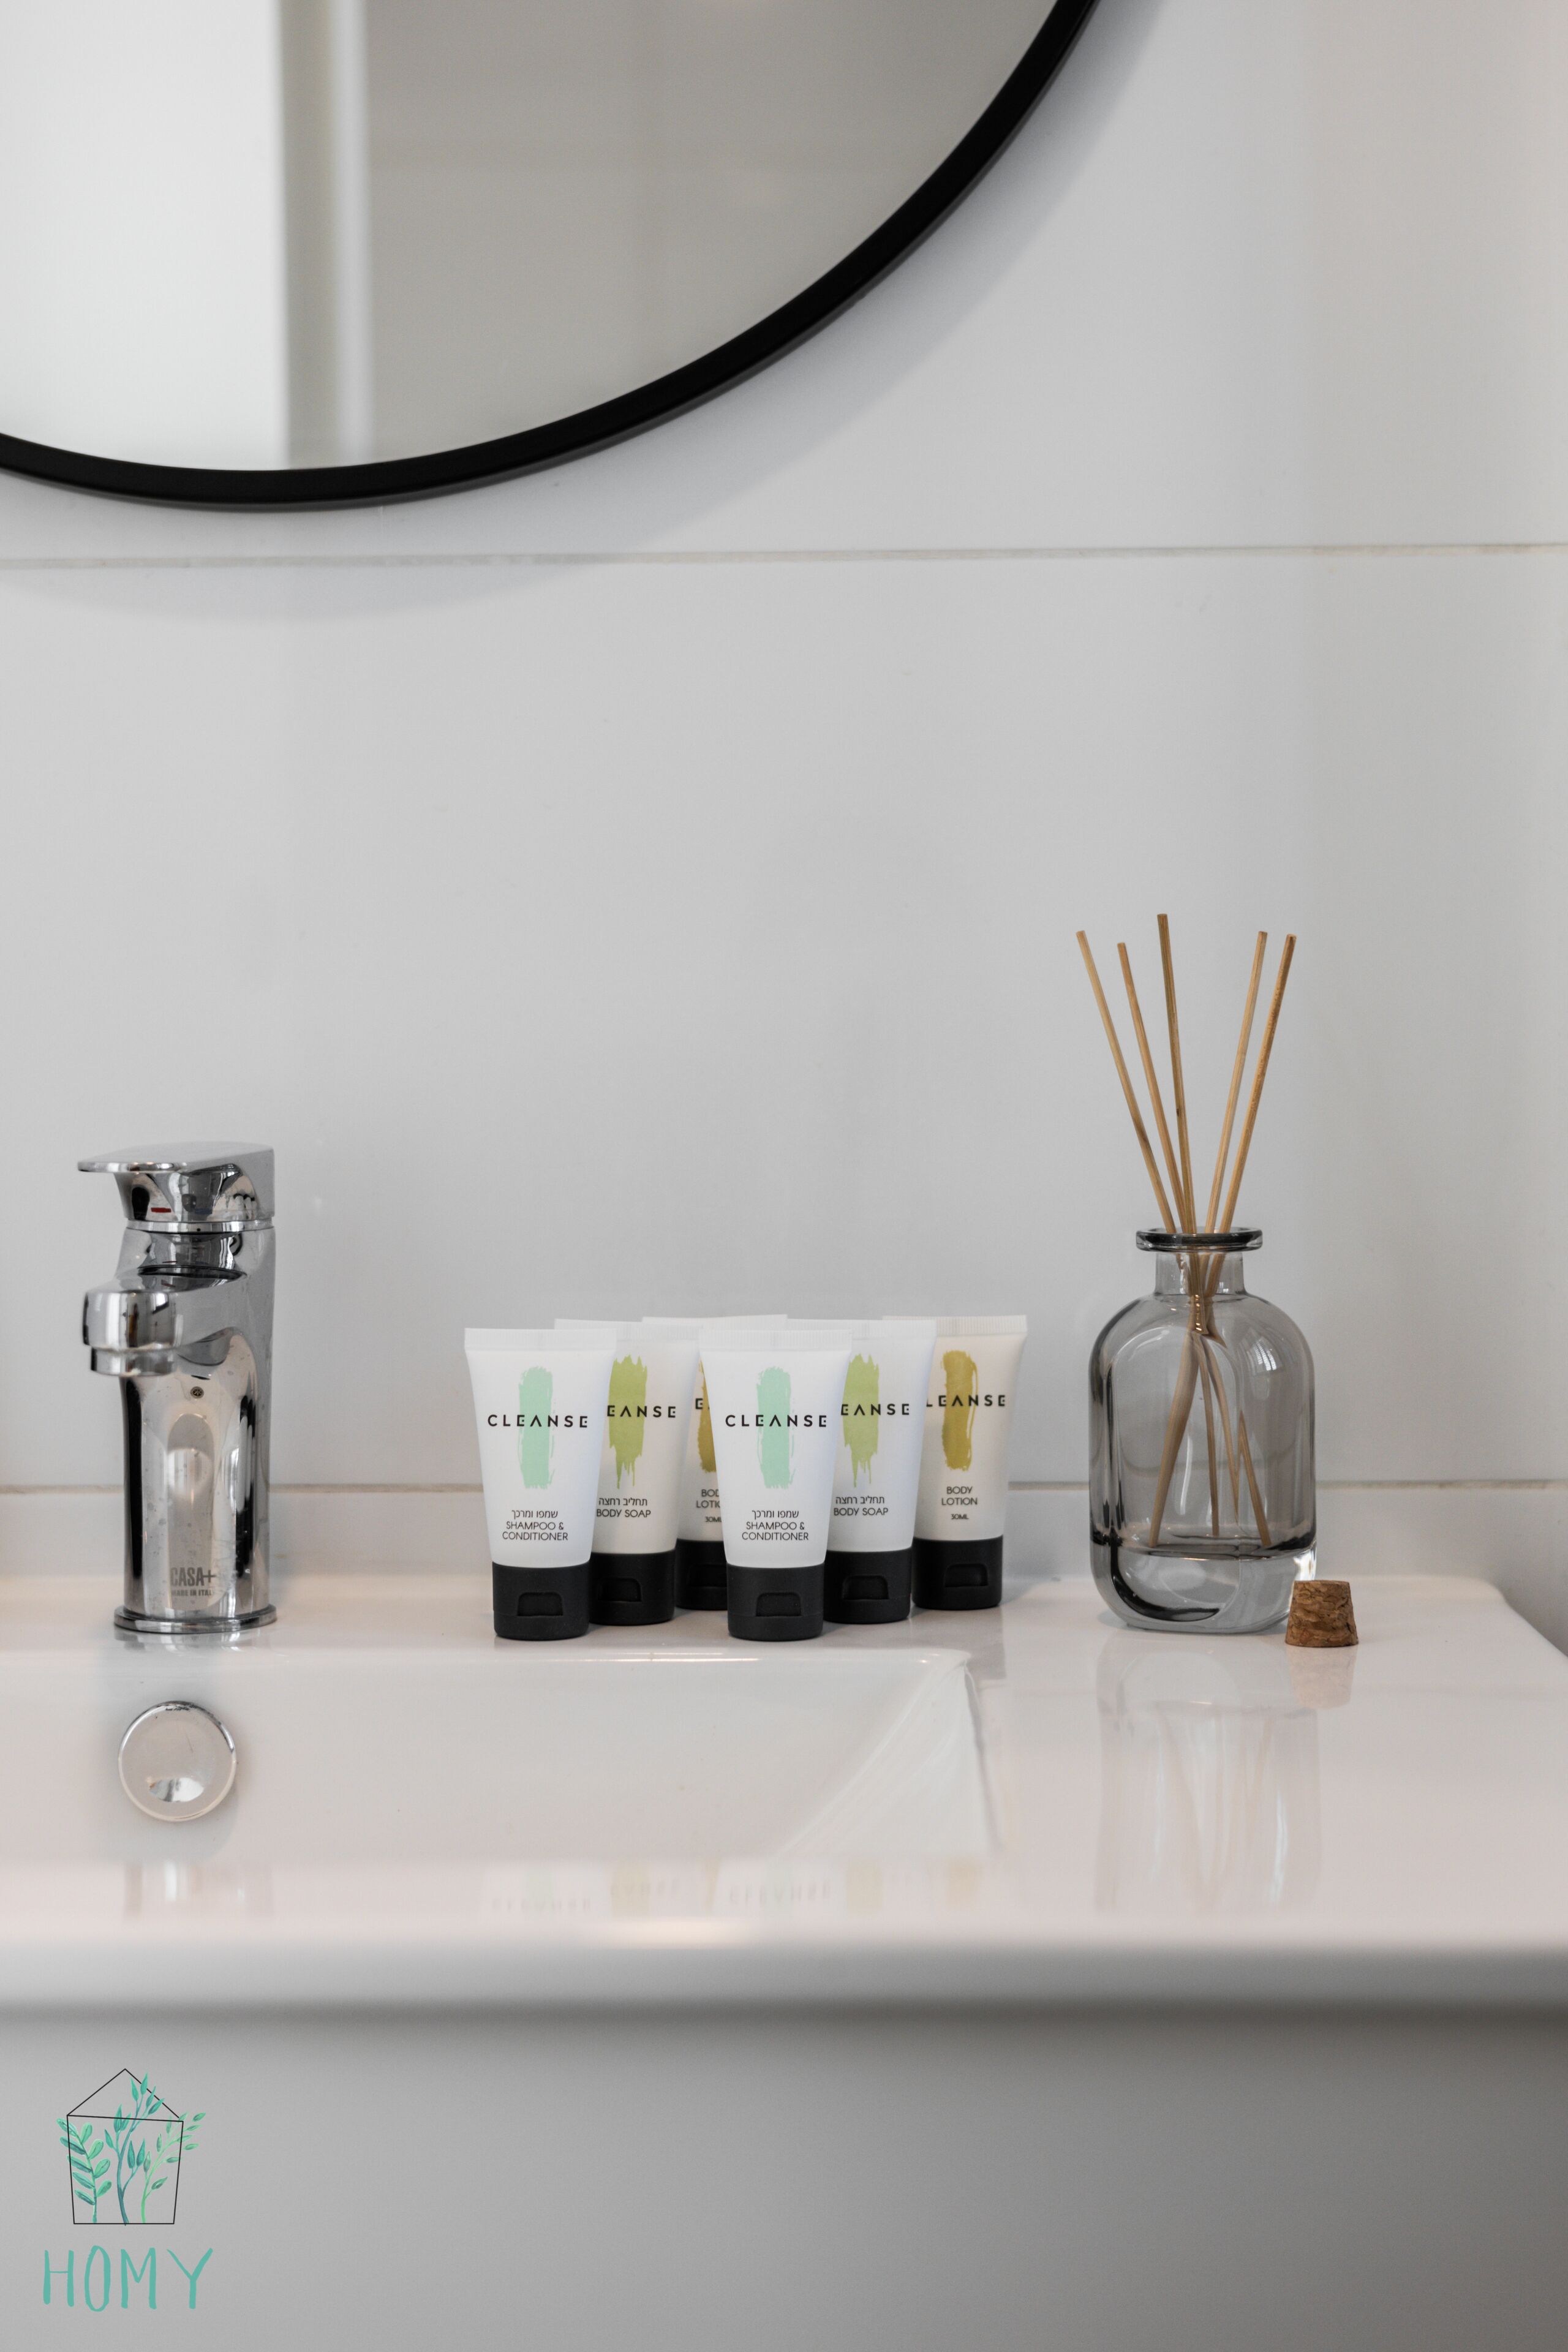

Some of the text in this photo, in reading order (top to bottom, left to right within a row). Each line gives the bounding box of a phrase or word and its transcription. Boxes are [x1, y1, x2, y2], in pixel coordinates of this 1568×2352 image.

[925, 1394, 1006, 1407] LEANSE
[607, 1404, 676, 1419] EANSE
[840, 1403, 910, 1416] EANSE
[488, 1414, 588, 1428] CLEANSE
[725, 1414, 827, 1428] CLEANSE
[701, 1488, 719, 1497] BOD
[946, 1486, 973, 1494] BODY
[622, 1497, 647, 1506] תחליב
[859, 1495, 885, 1504] תחליב
[941, 1497, 978, 1506] LOTION
[511, 1510, 559, 1520] שמפו ומרכך
[596, 1508, 651, 1518] BODY SOAP
[752, 1510, 799, 1520] שמפו ומרכך
[833, 1507, 889, 1517] BODY SOAP
[506, 1521, 556, 1531] SHAMPOO
[745, 1521, 805, 1531] SHAMPOO &
[502, 1531, 568, 1541] CONDITIONER
[742, 1531, 809, 1541] CONDITIONER
